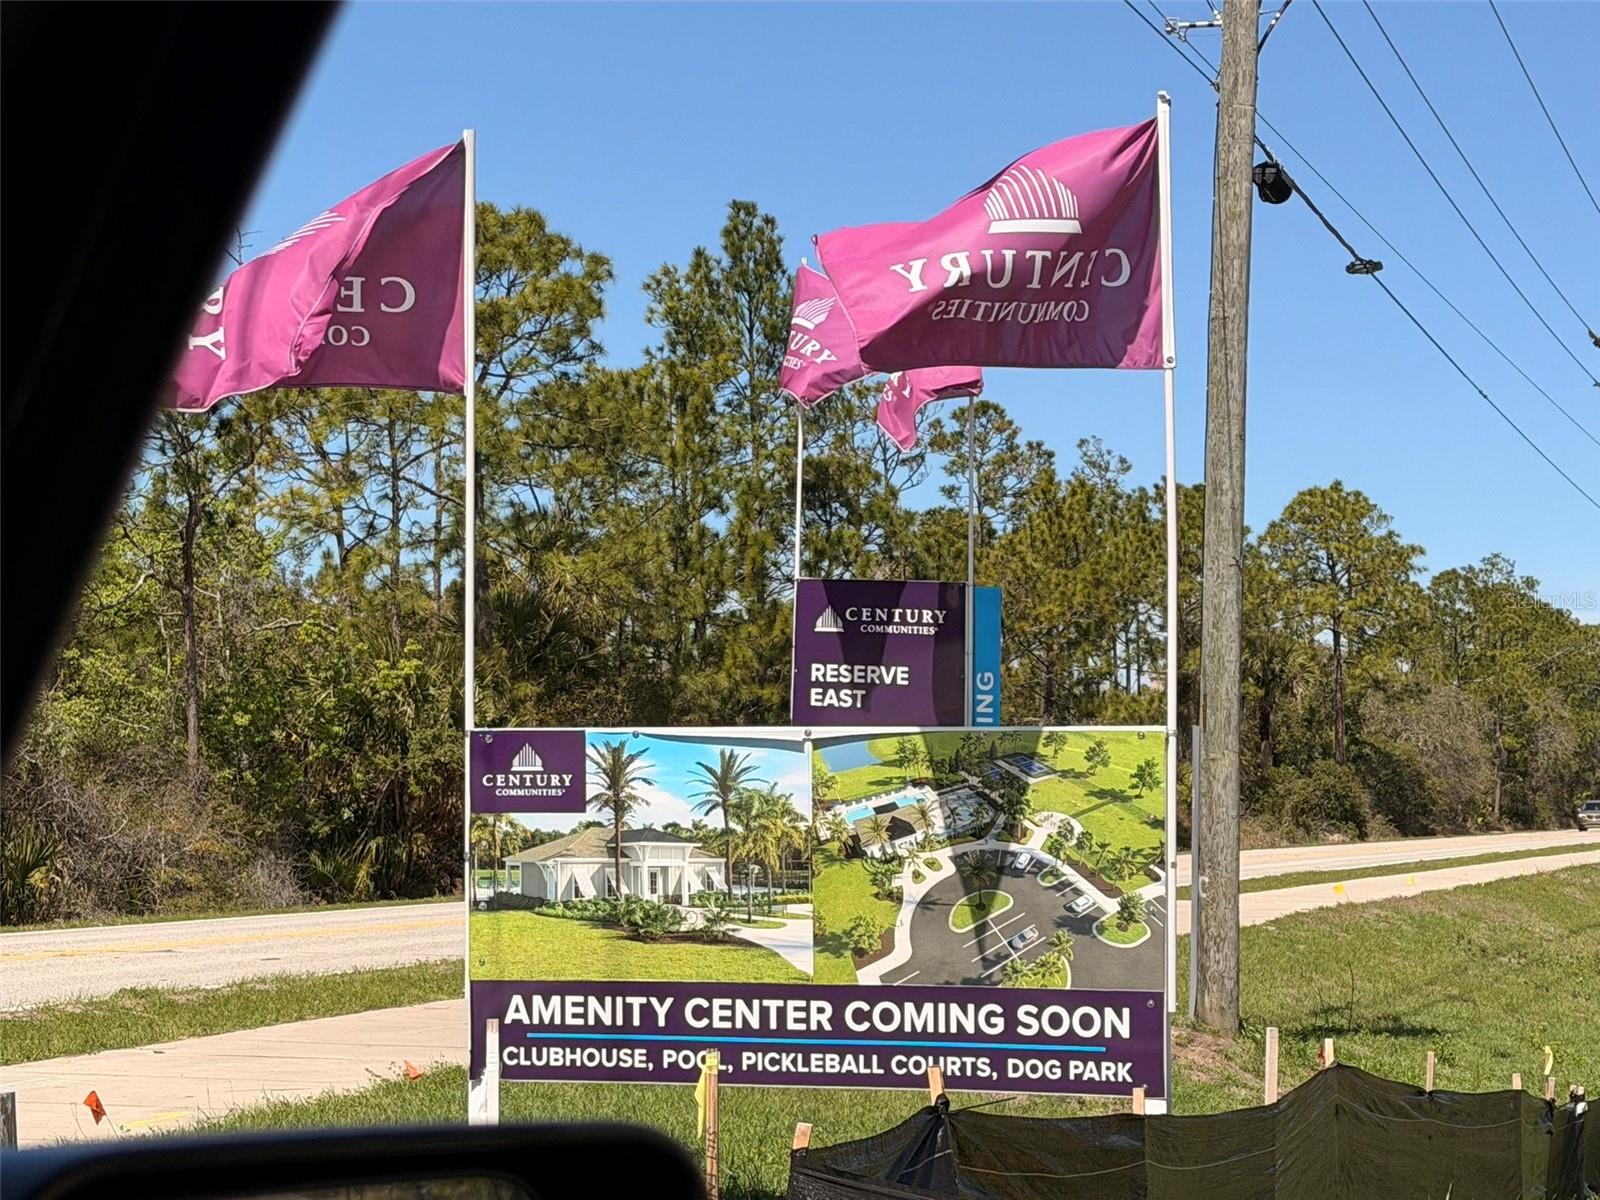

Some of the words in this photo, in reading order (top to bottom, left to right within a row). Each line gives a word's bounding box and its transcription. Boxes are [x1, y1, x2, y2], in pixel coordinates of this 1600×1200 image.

[845, 607, 947, 624] CENTURY
[860, 624, 936, 635] COMMUNITIES
[810, 663, 910, 685] RESERVE
[810, 688, 866, 708] EAST
[482, 774, 573, 787] CENTURY
[495, 788, 563, 797] COMMUNITIES
[503, 994, 675, 1028] AMENITY
[684, 997, 833, 1031] CENTER
[844, 1000, 1005, 1035] COMING
[1016, 1004, 1131, 1039] SOON
[502, 1046, 654, 1072] CLUBHOUSE,
[741, 1051, 885, 1076] PICKLEBALL
[1007, 1058, 1062, 1080] DOG
[1069, 1061, 1133, 1083] PARK
